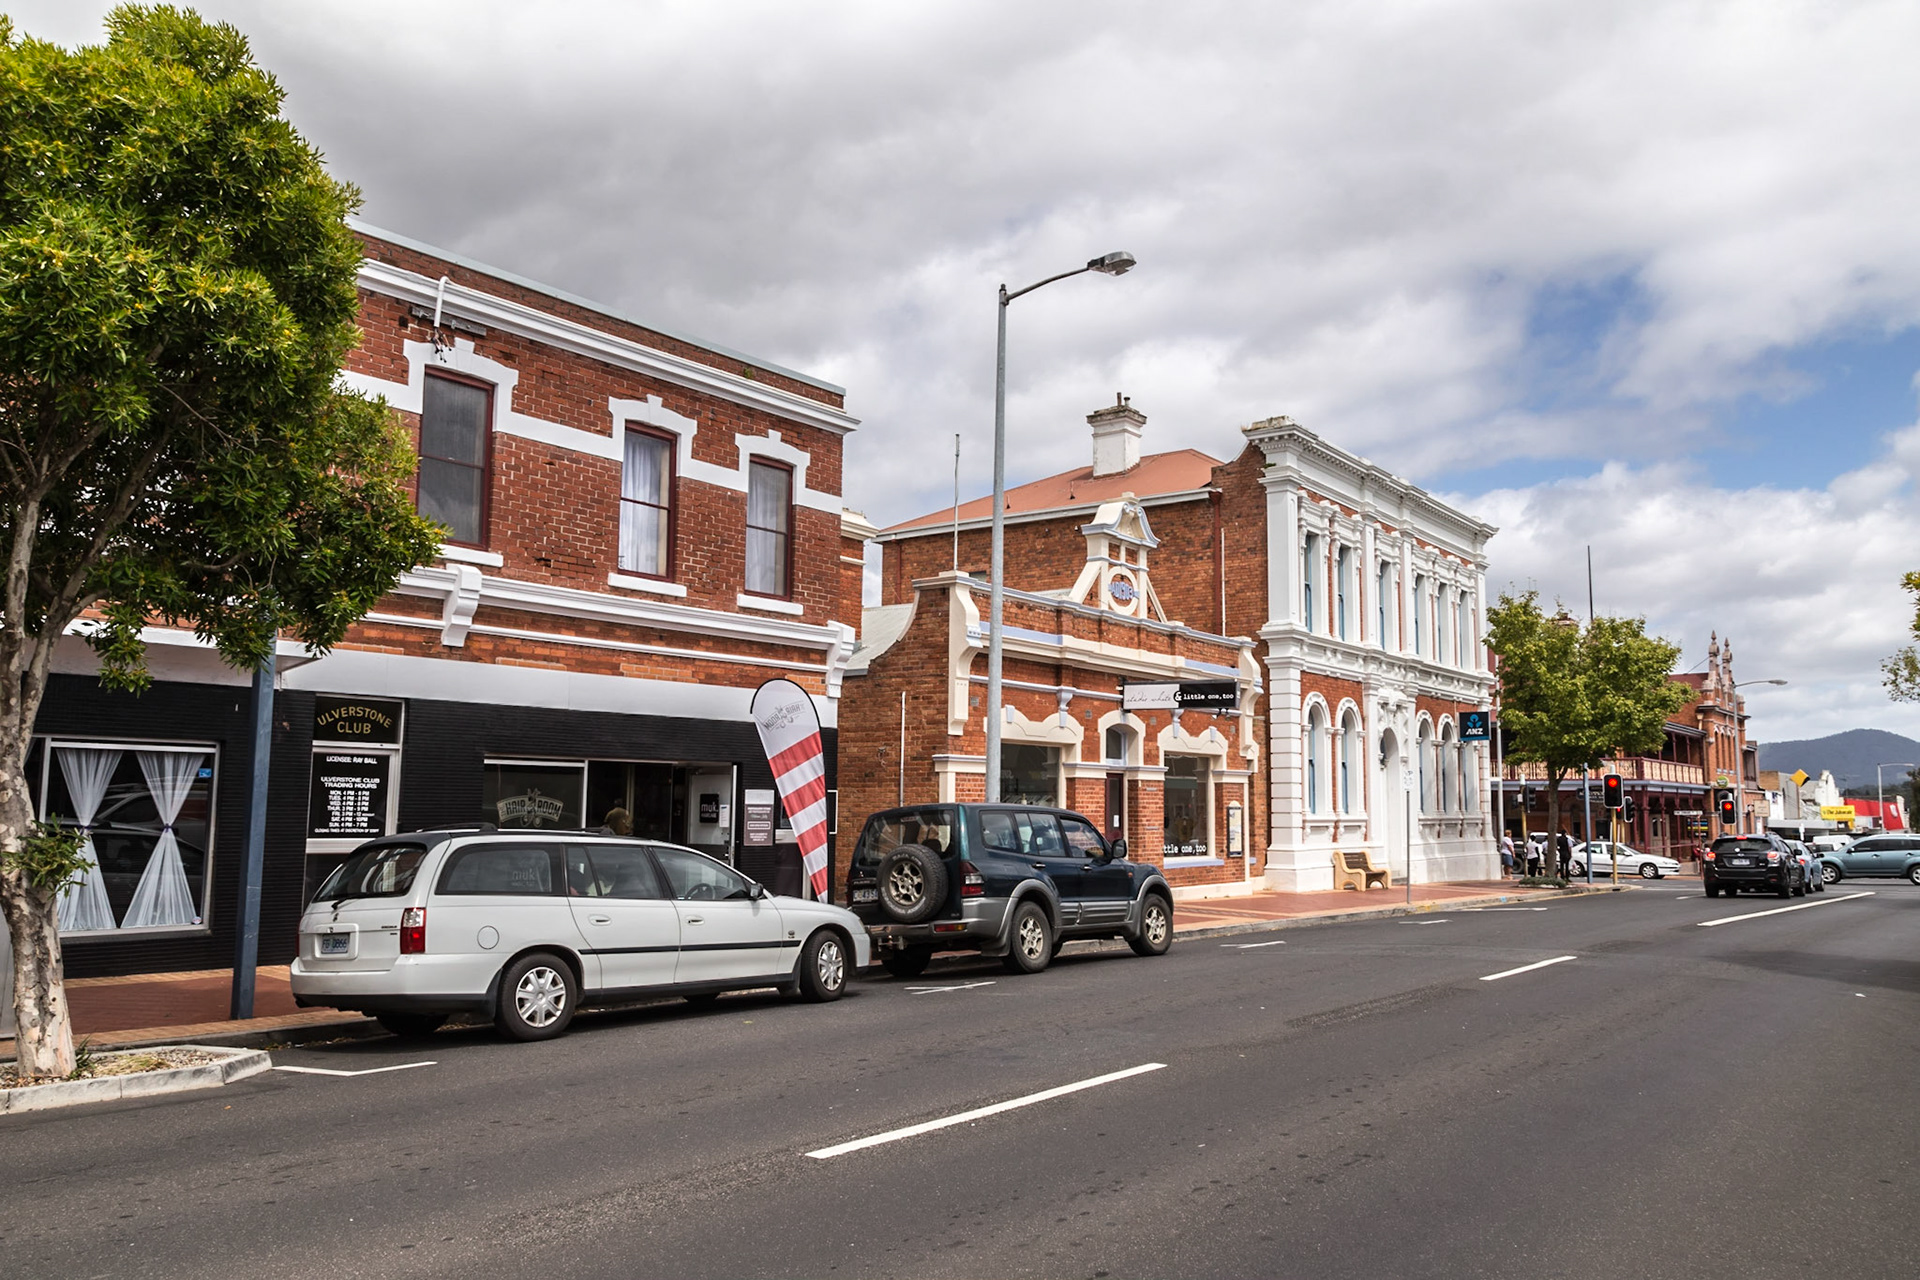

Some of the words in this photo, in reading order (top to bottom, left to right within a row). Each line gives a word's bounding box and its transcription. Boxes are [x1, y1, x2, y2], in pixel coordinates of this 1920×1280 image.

[1183, 692, 1206, 700] little
[317, 706, 392, 728] ULVERSTONE
[337, 721, 372, 734] CLUB
[364, 757, 378, 765] BALL
[505, 800, 526, 815] HAIR
[538, 800, 561, 817] ROOM
[701, 802, 718, 812] muk.
[1164, 844, 1178, 853] ttle
